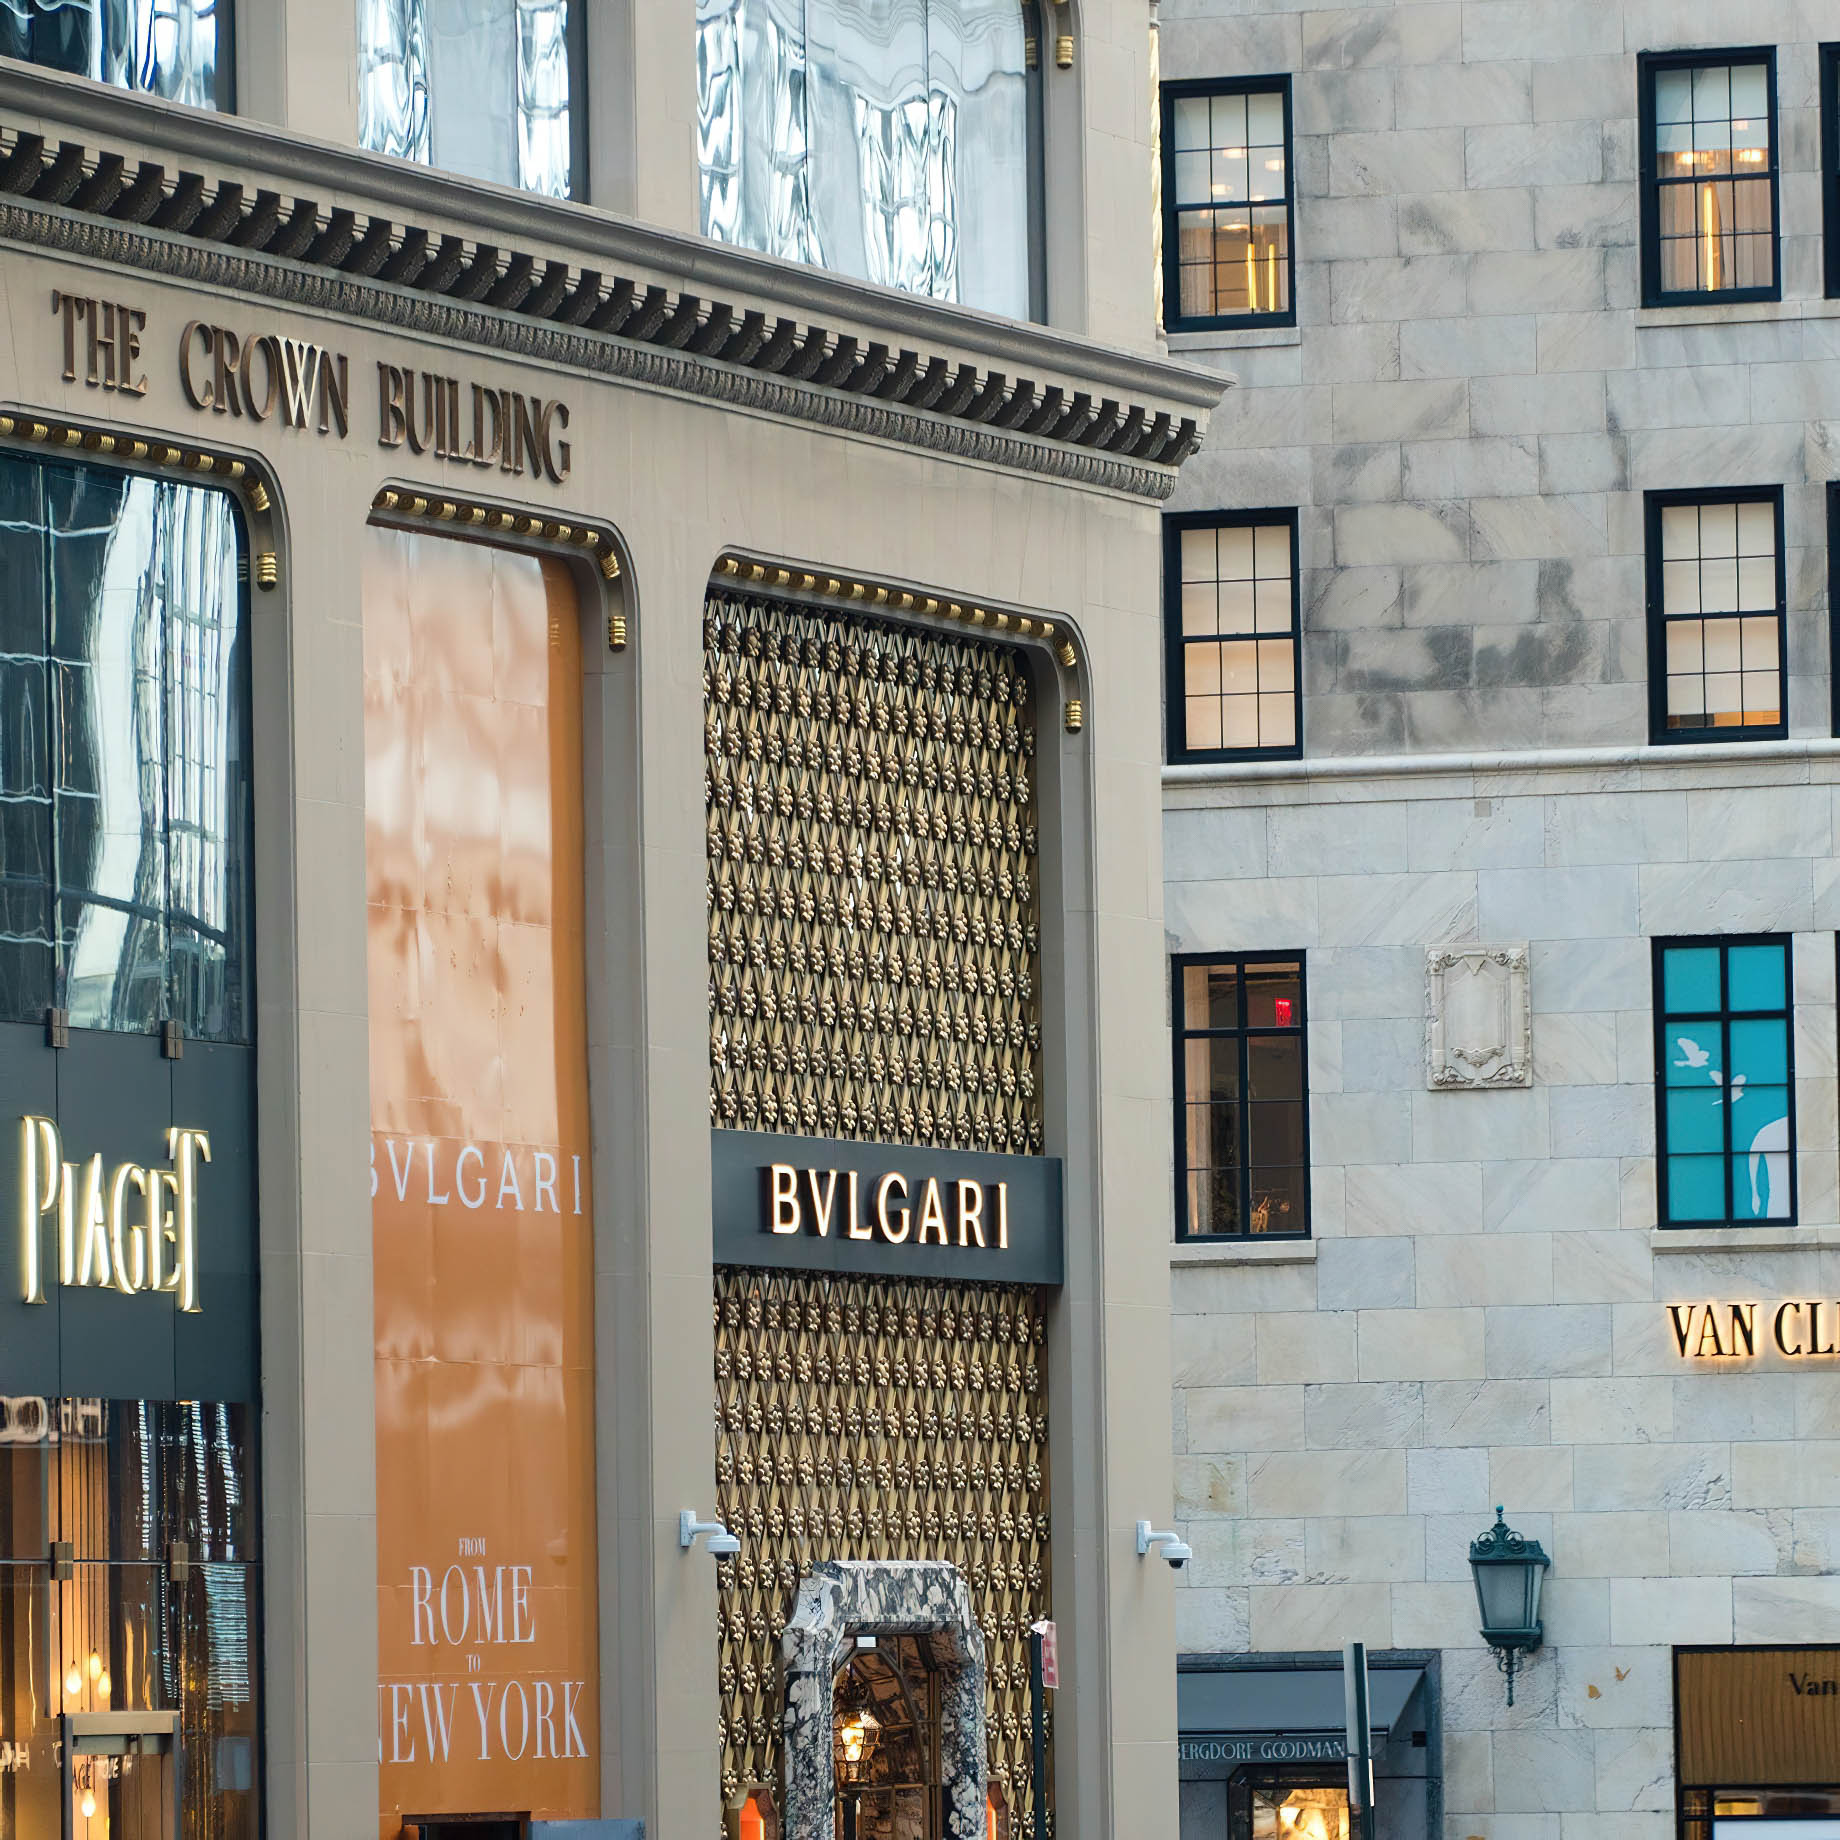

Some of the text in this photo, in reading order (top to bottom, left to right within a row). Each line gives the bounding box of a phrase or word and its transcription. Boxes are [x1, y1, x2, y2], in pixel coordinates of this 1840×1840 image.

[52, 289, 572, 484] THE CROWN BUILDING
[19, 1115, 213, 1314] PIAGET
[770, 1163, 1009, 1250] BVLGARI
[1665, 1302, 1840, 1358] VAN CL
[458, 1537, 486, 1557] FROM
[408, 1564, 536, 1646] ROME
[465, 1654, 481, 1673] TO
[1788, 1672, 1838, 1696] Van
[468, 1680, 590, 1761] YORK
